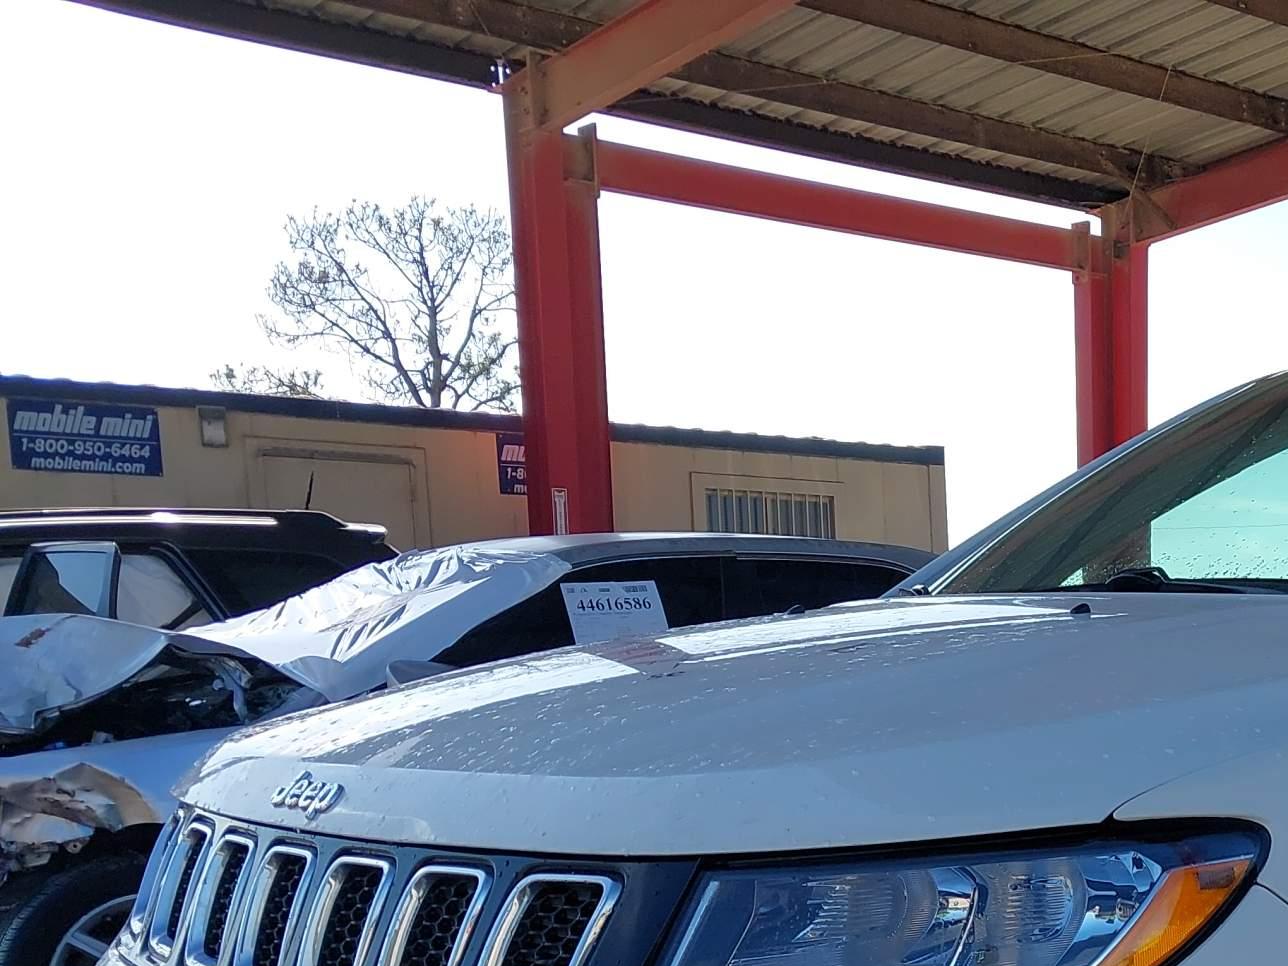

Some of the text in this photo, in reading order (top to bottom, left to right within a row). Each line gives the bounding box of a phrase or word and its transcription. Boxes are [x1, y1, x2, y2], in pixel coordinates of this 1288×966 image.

[13, 404, 153, 438] mobile mini
[21, 437, 151, 459] 1-800-950-6464
[30, 456, 146, 474] mobilemini.com
[576, 596, 652, 612] 44616586
[271, 769, 346, 821] Jeep
